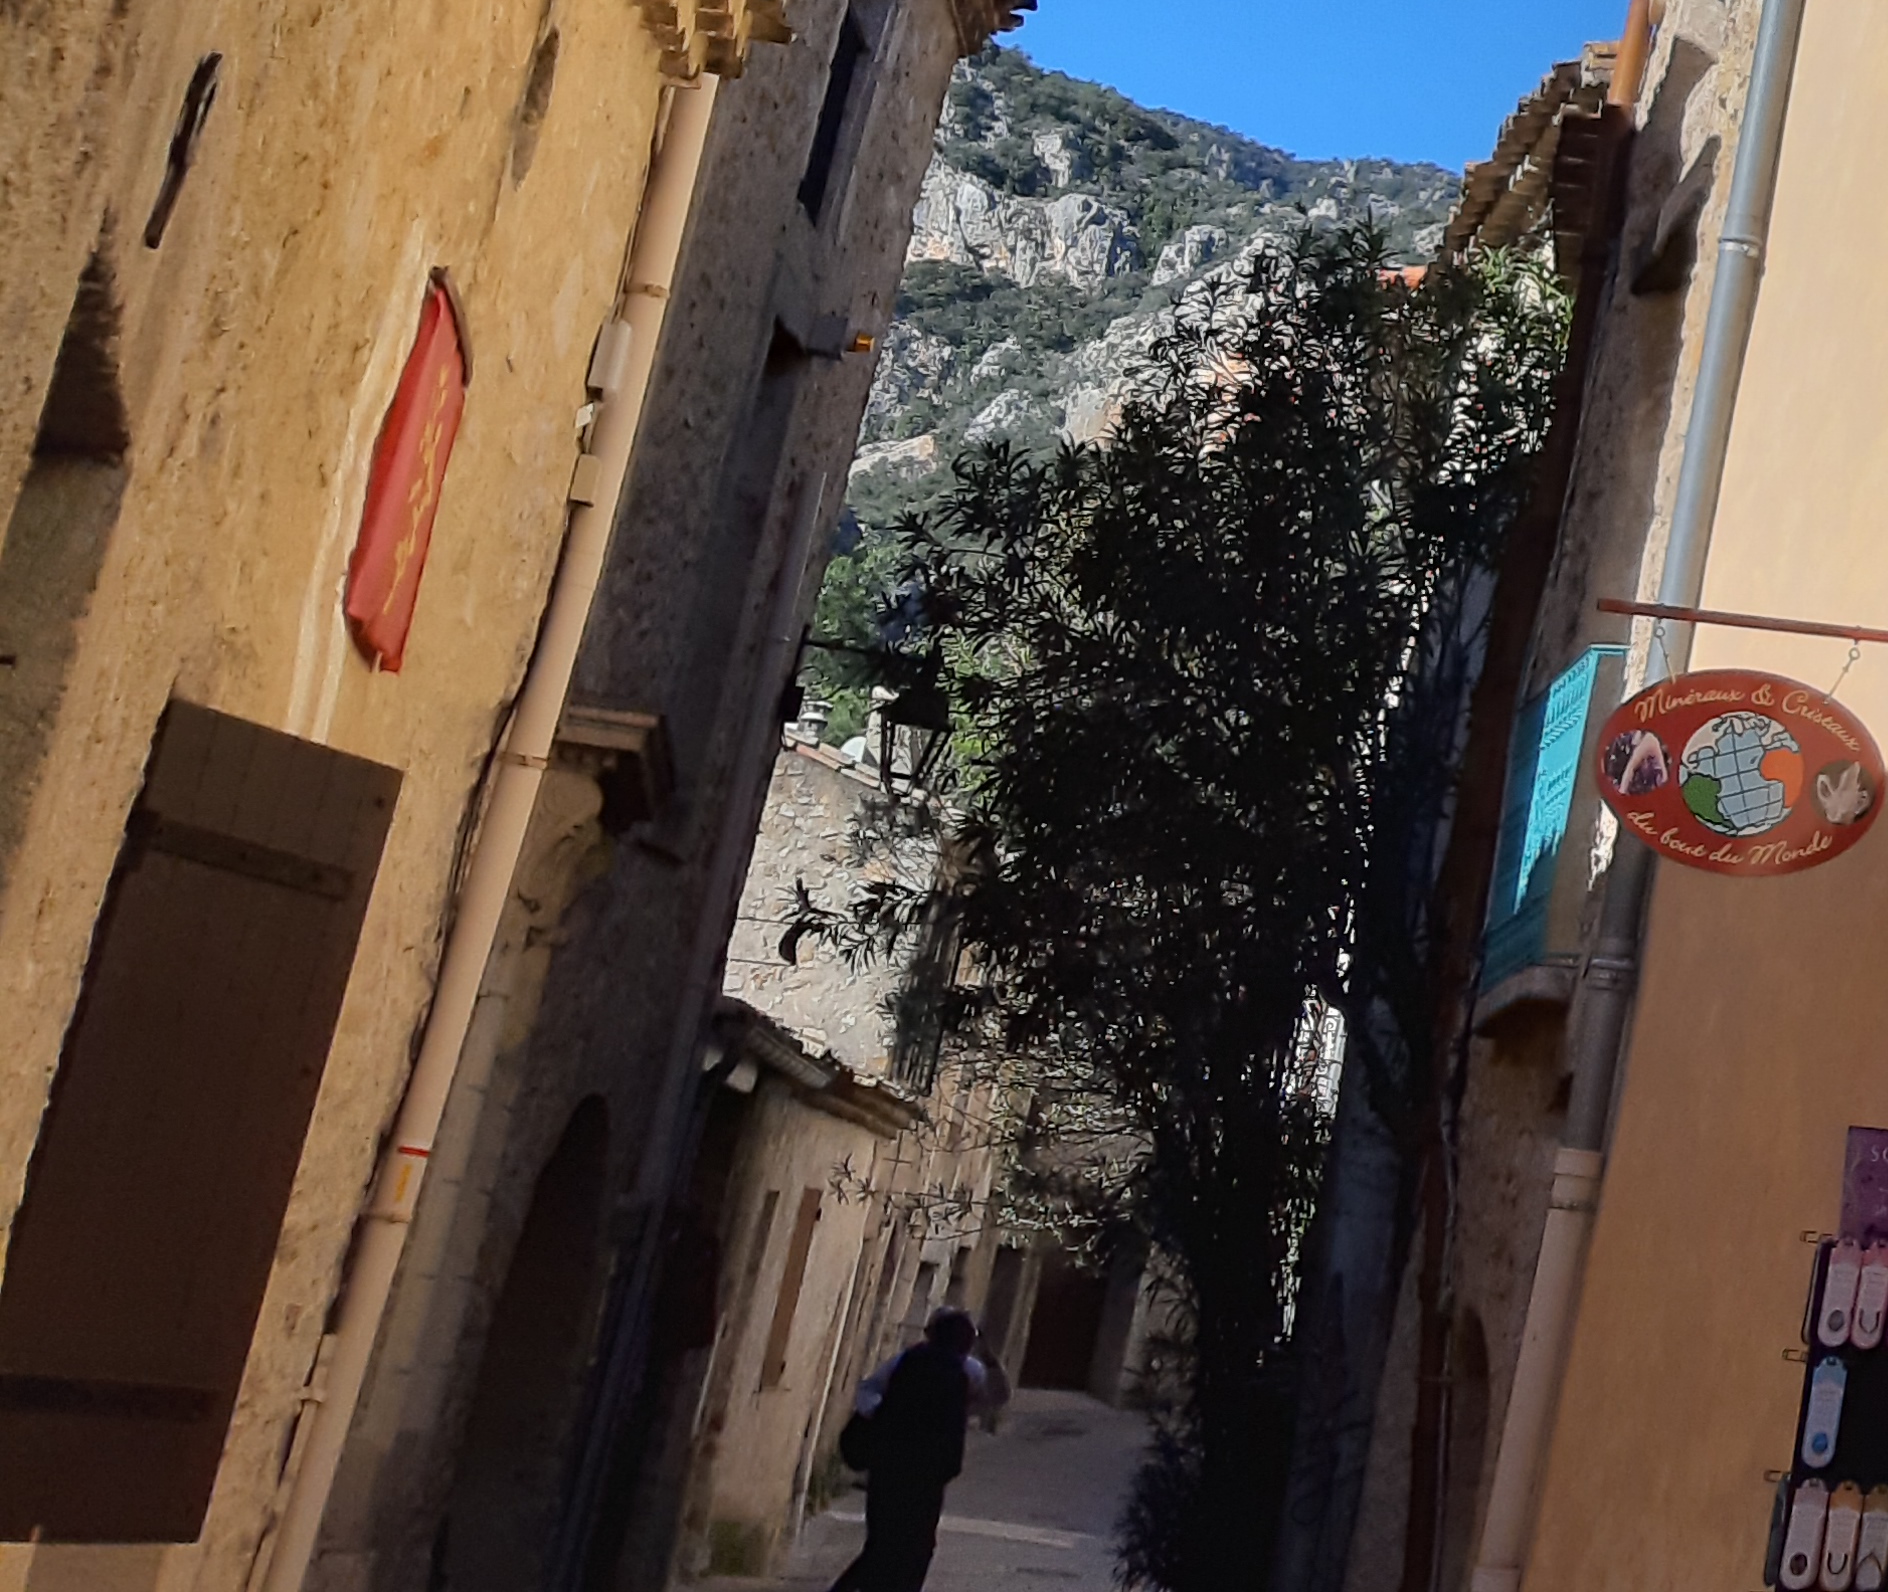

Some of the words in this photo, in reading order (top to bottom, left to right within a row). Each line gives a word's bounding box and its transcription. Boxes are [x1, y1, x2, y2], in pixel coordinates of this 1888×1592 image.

[1634, 685, 1745, 723] Minéraux
[1751, 683, 1775, 707] &
[1782, 690, 1861, 752] Cristaux
[1626, 810, 1658, 836] du
[1659, 827, 1707, 858] bout
[1708, 843, 1745, 865] du
[1748, 830, 1833, 866] Monde
